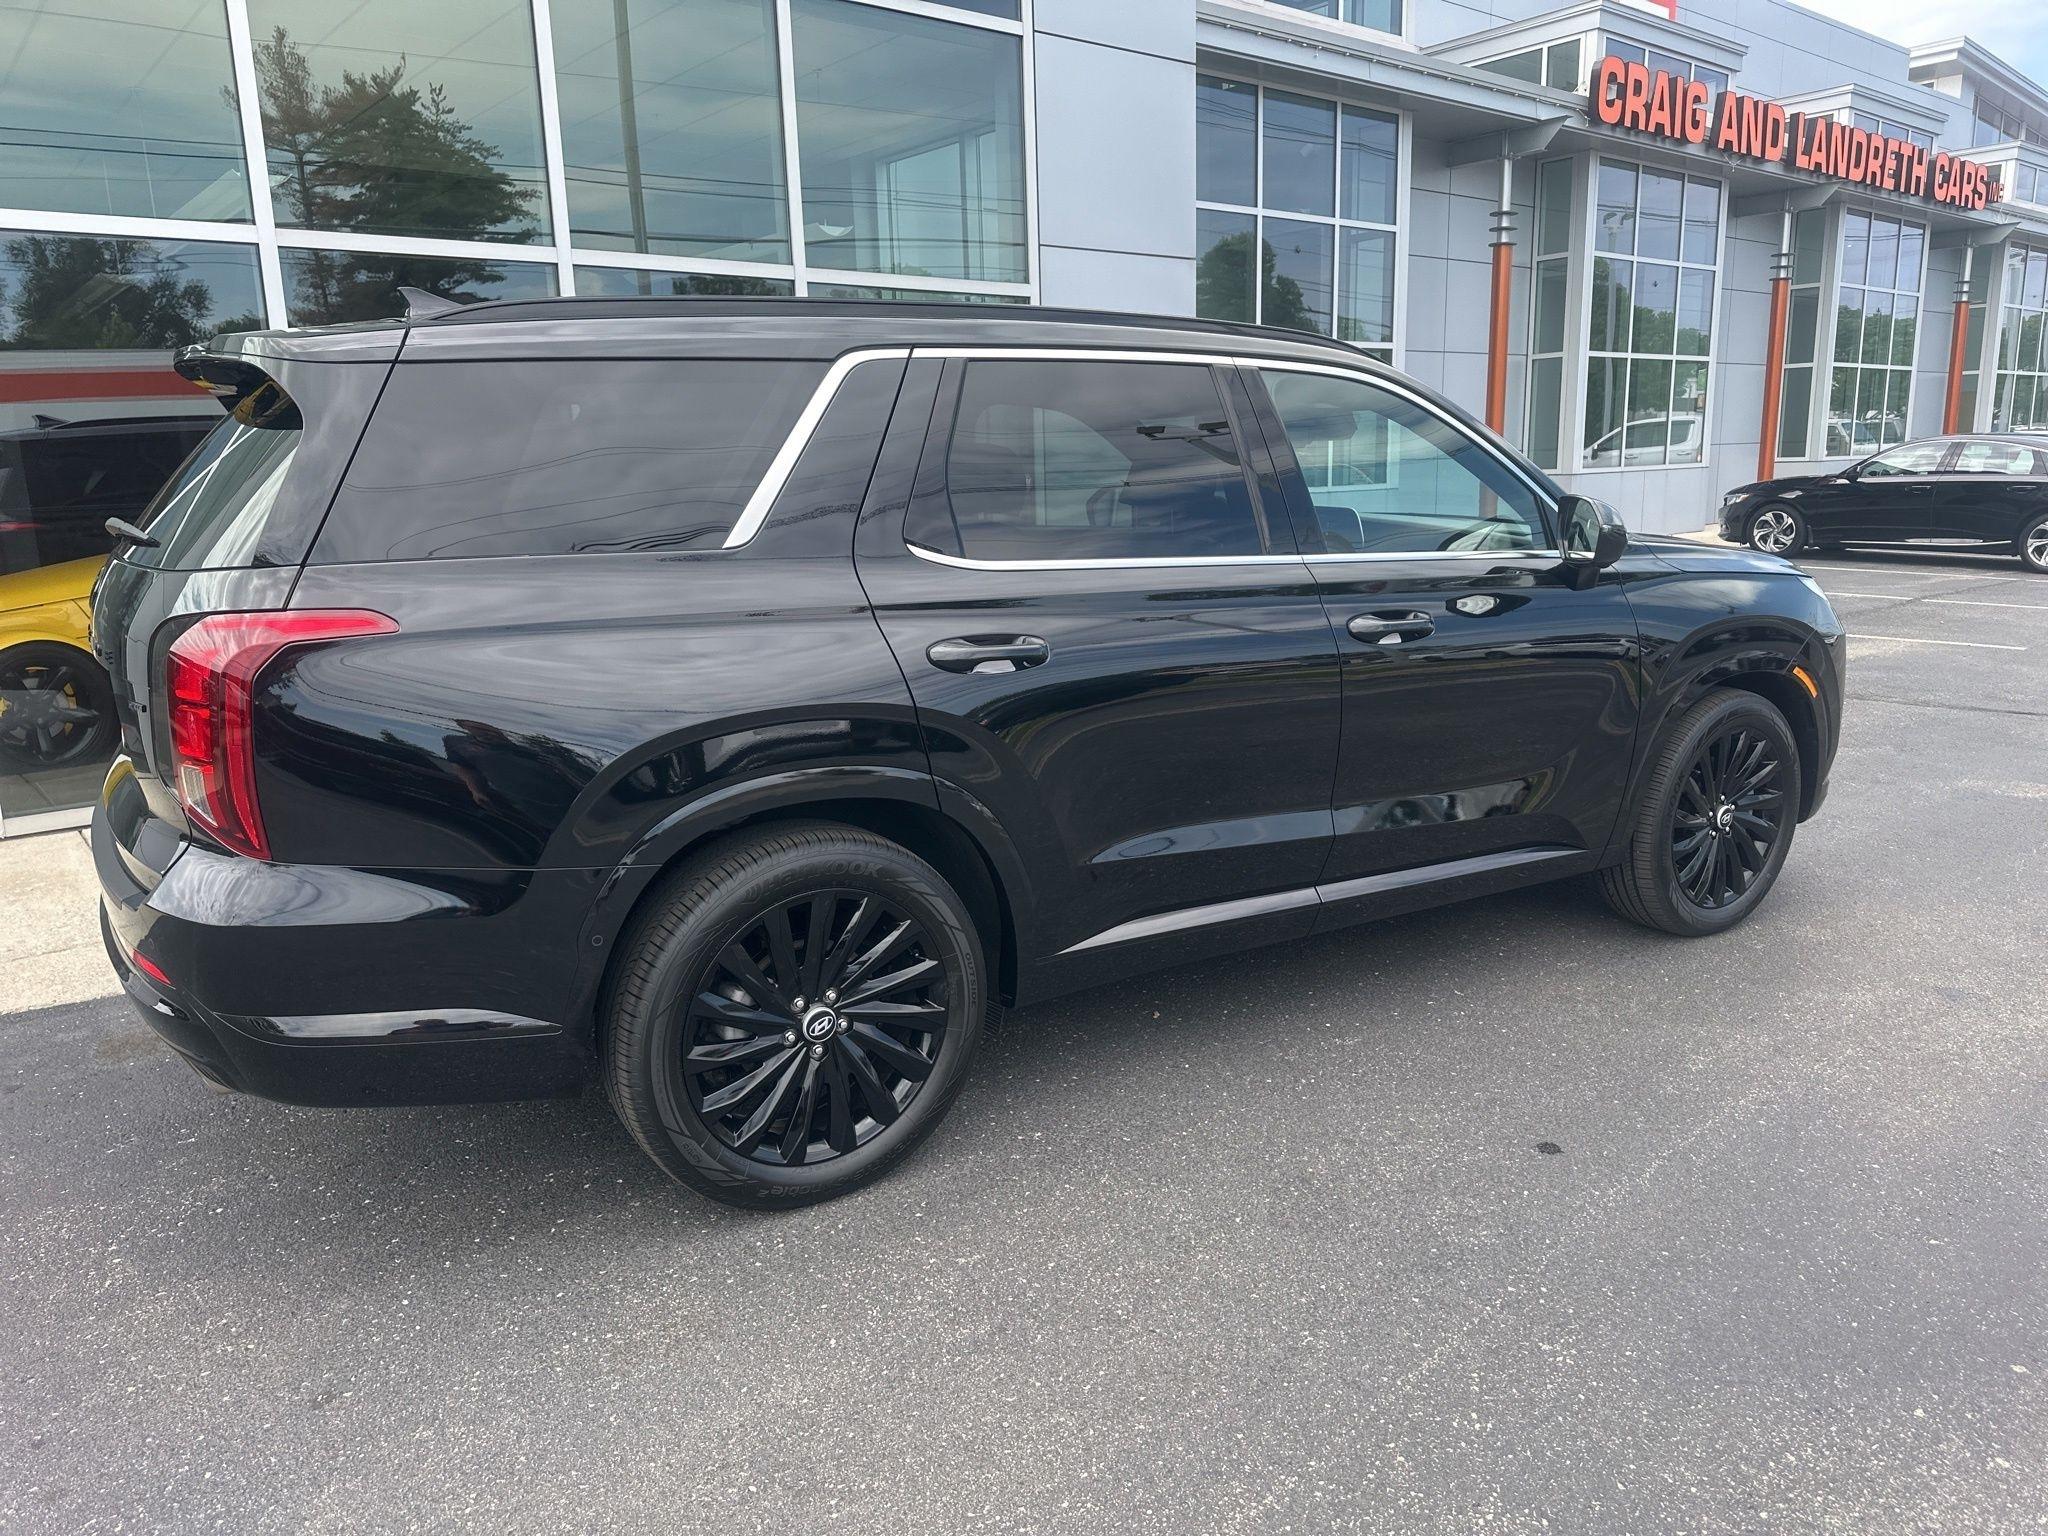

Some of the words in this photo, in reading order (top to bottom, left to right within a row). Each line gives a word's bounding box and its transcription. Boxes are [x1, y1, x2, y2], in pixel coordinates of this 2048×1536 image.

[1597, 55, 1709, 144] CRAIG
[1716, 91, 1786, 162] AND
[1795, 112, 1929, 197] LANDRETH
[1934, 152, 1988, 210] CARS
